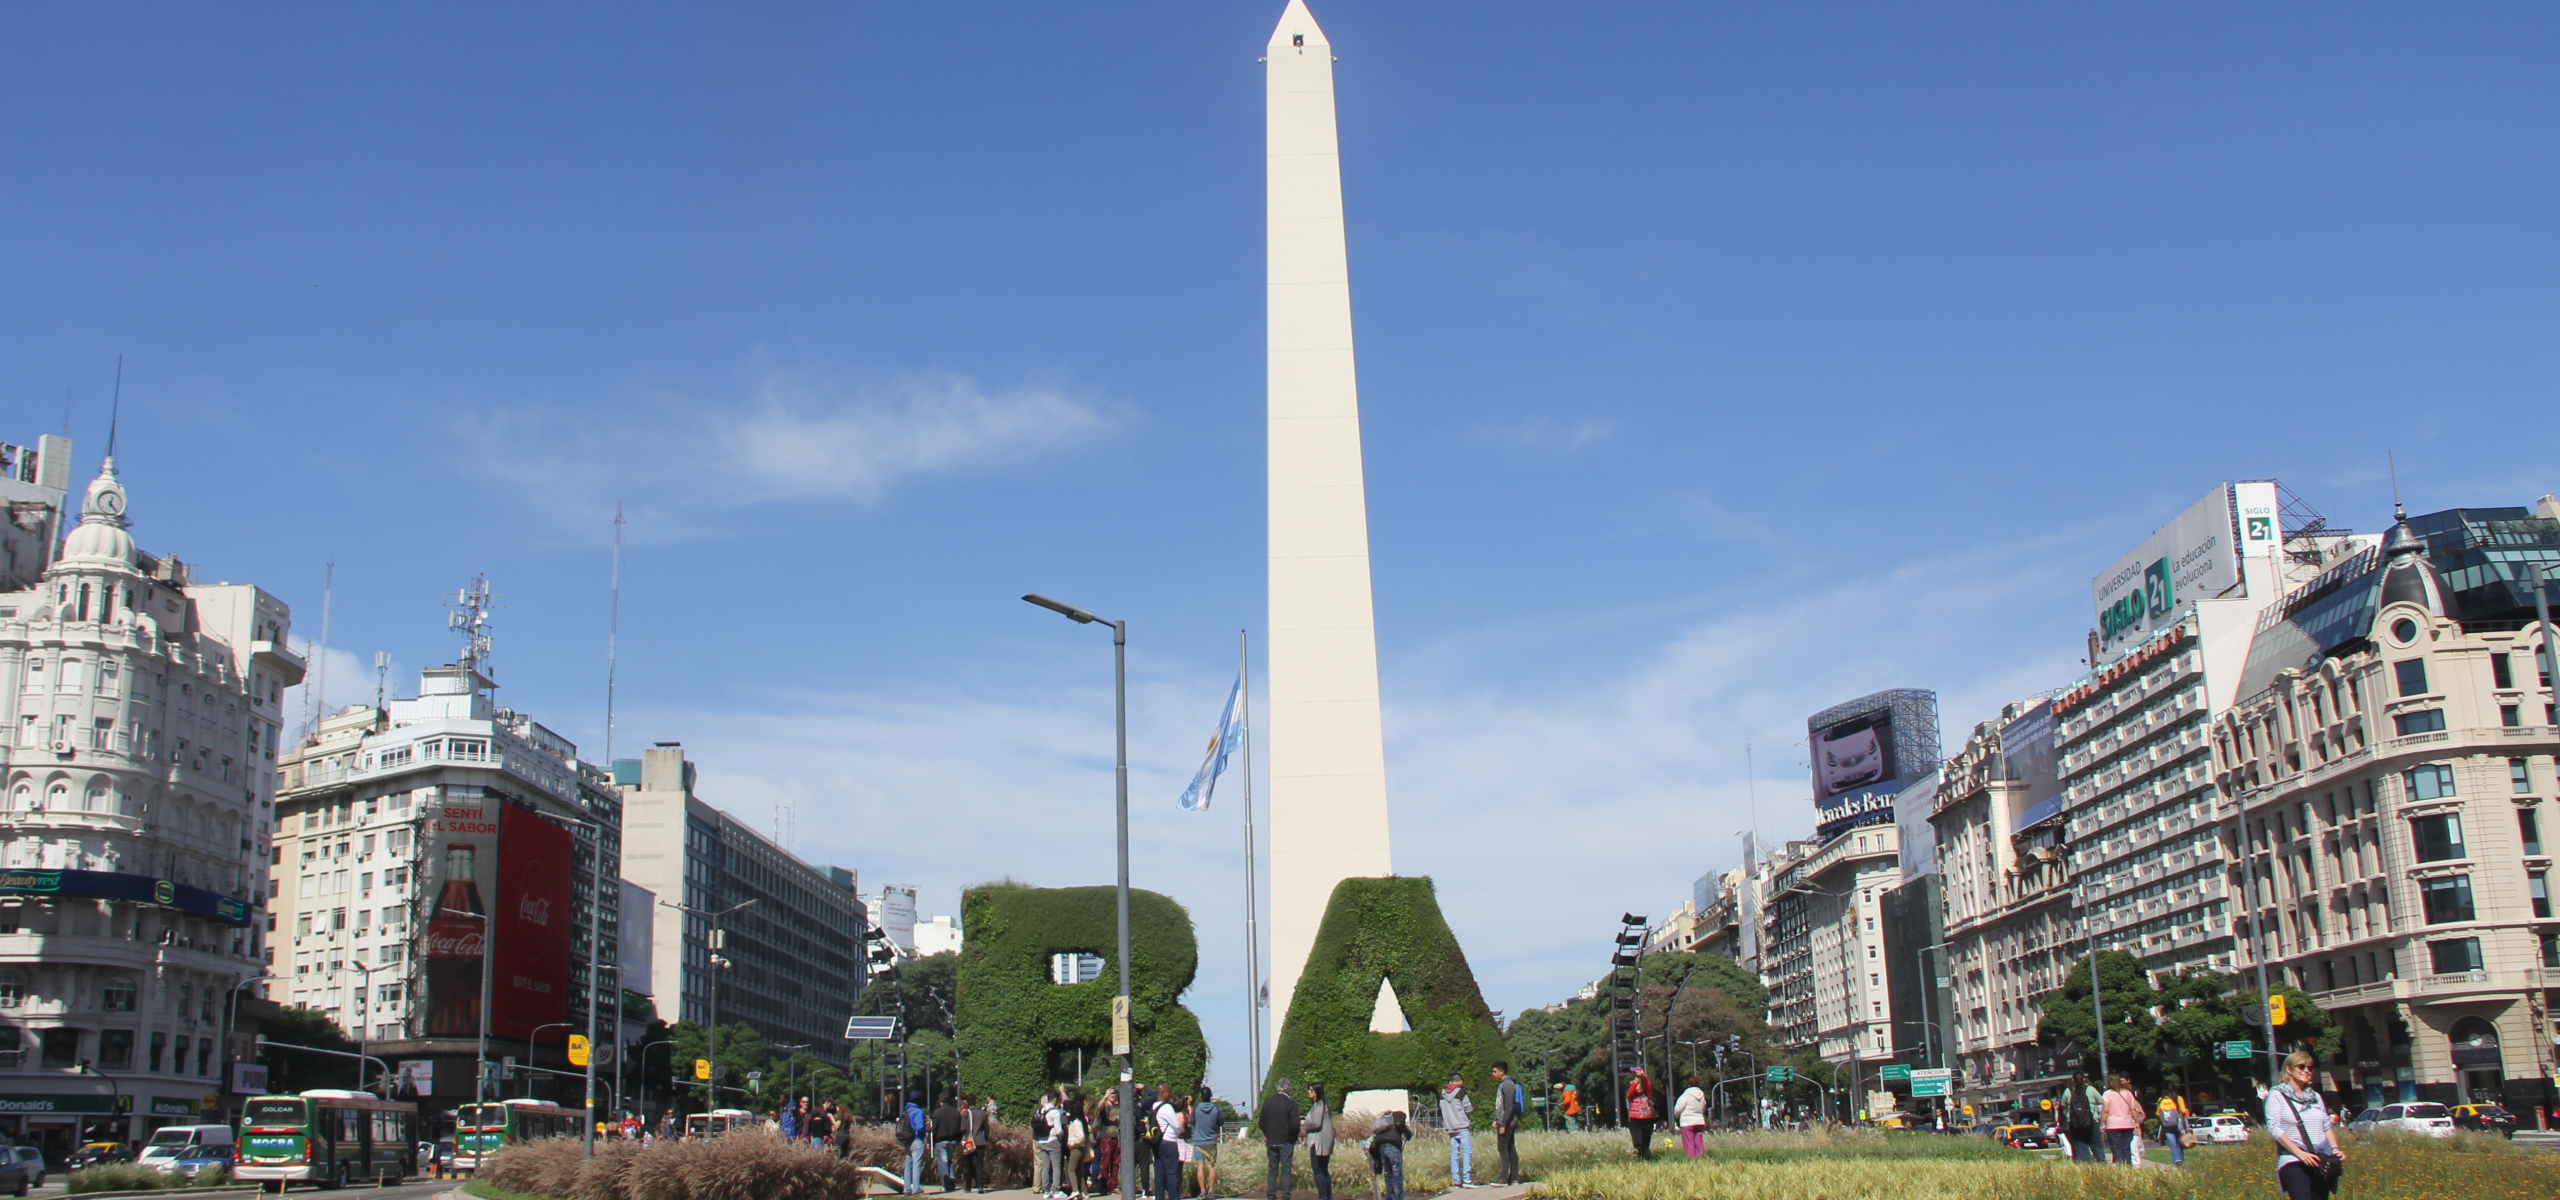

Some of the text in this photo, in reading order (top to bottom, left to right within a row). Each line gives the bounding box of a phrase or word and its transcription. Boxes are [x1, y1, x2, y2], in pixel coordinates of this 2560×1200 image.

[2245, 507, 2271, 515] SIGLO
[2251, 521, 2270, 540] 21
[2172, 535, 2217, 574] La educación
[2098, 561, 2142, 602] UNIVERSIDAD
[2175, 558, 2213, 592] evoluciona
[2100, 574, 2167, 642] SIGLO 21
[443, 807, 484, 820] SENTÍ
[449, 821, 497, 834] SABOR
[528, 979, 533, 991] EL
[534, 981, 551, 994] SABOR
[155, 1103, 188, 1114] McDonald's
[251, 1138, 295, 1147] MOCBA
